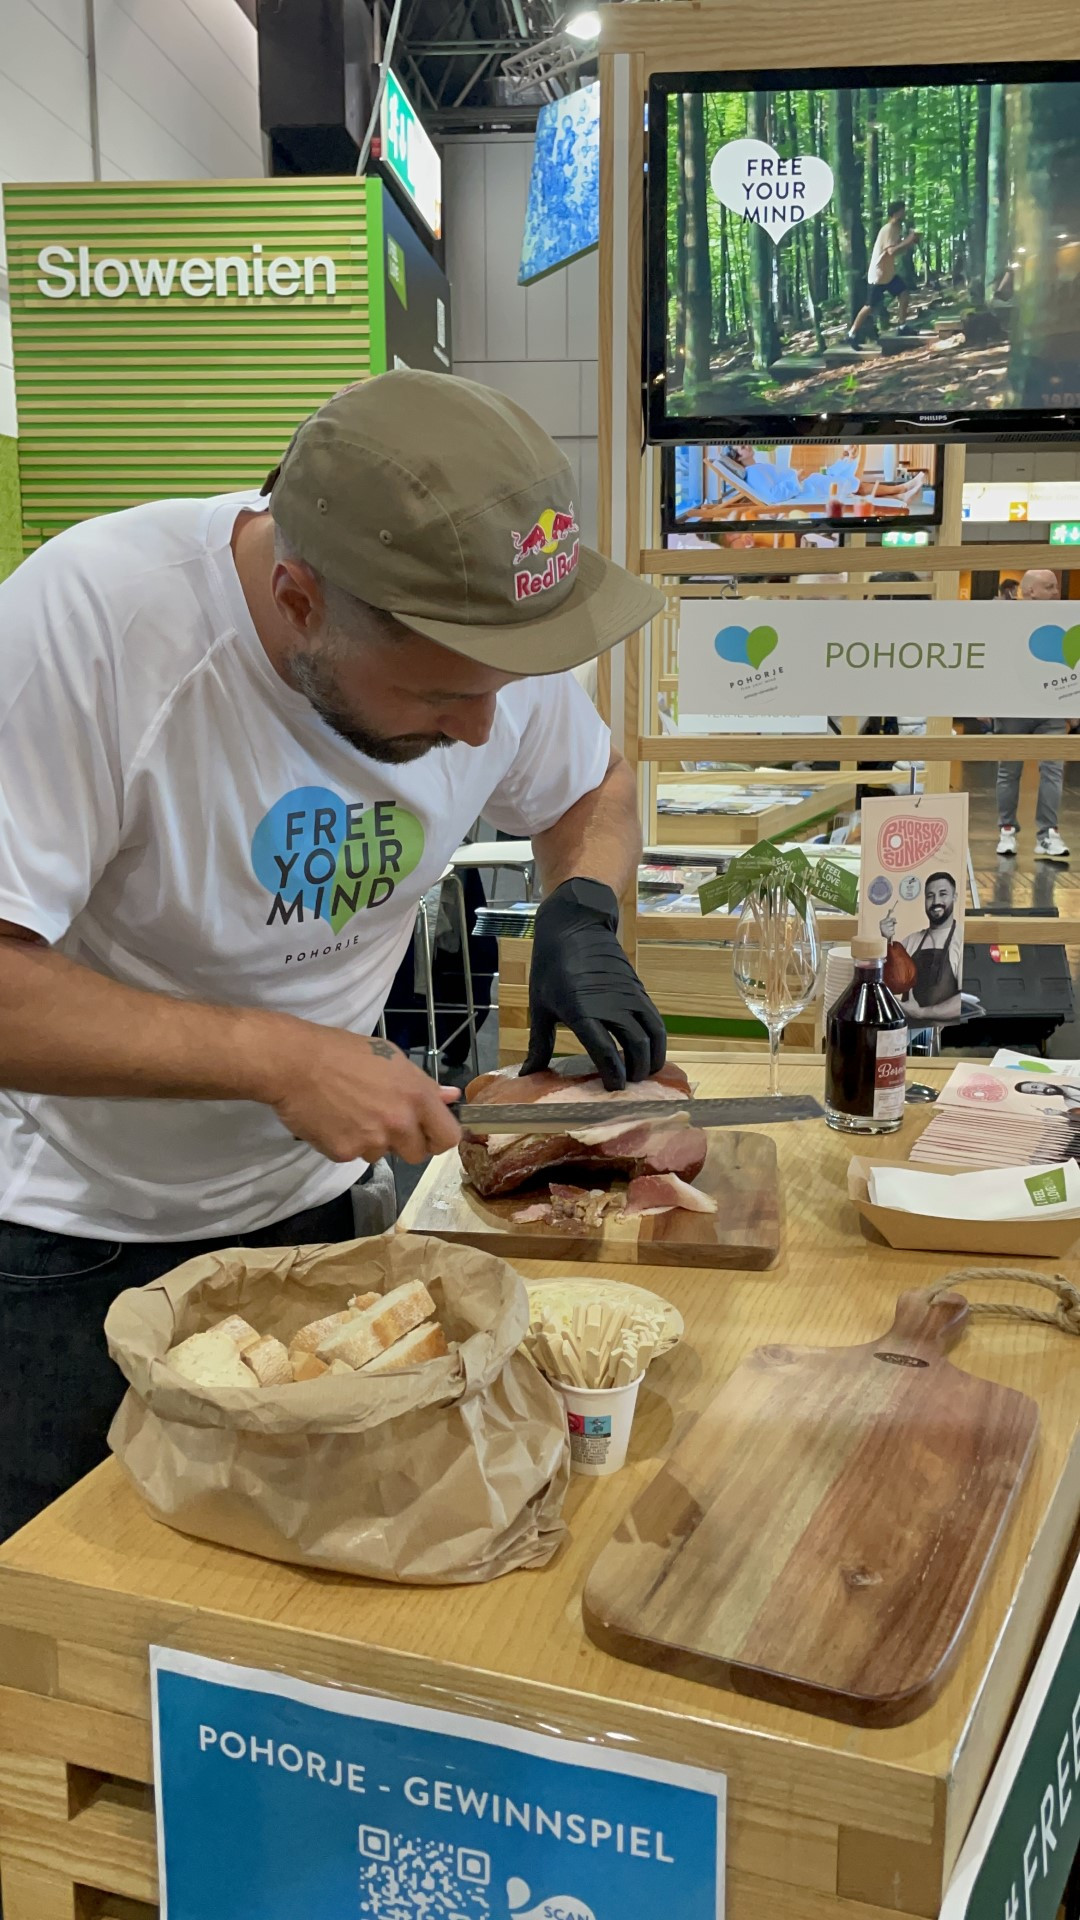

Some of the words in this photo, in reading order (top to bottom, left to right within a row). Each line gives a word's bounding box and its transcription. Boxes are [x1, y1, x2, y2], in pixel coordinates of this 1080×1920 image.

[747, 158, 802, 176] FREE
[742, 182, 805, 200] YOUR
[743, 205, 805, 224] MIND
[37, 243, 336, 298] Slowenien
[514, 558, 555, 601] Red
[826, 642, 986, 669] POHORJE
[729, 666, 784, 688] POHORJE
[286, 801, 396, 850] FREE
[274, 839, 403, 889] YOUR
[824, 864, 841, 878] FEEL
[266, 877, 395, 925] MIND
[285, 935, 360, 964] POHORJE
[200, 1725, 366, 1794] POHORJE
[403, 1776, 675, 1864] GEWINNSPIEL
